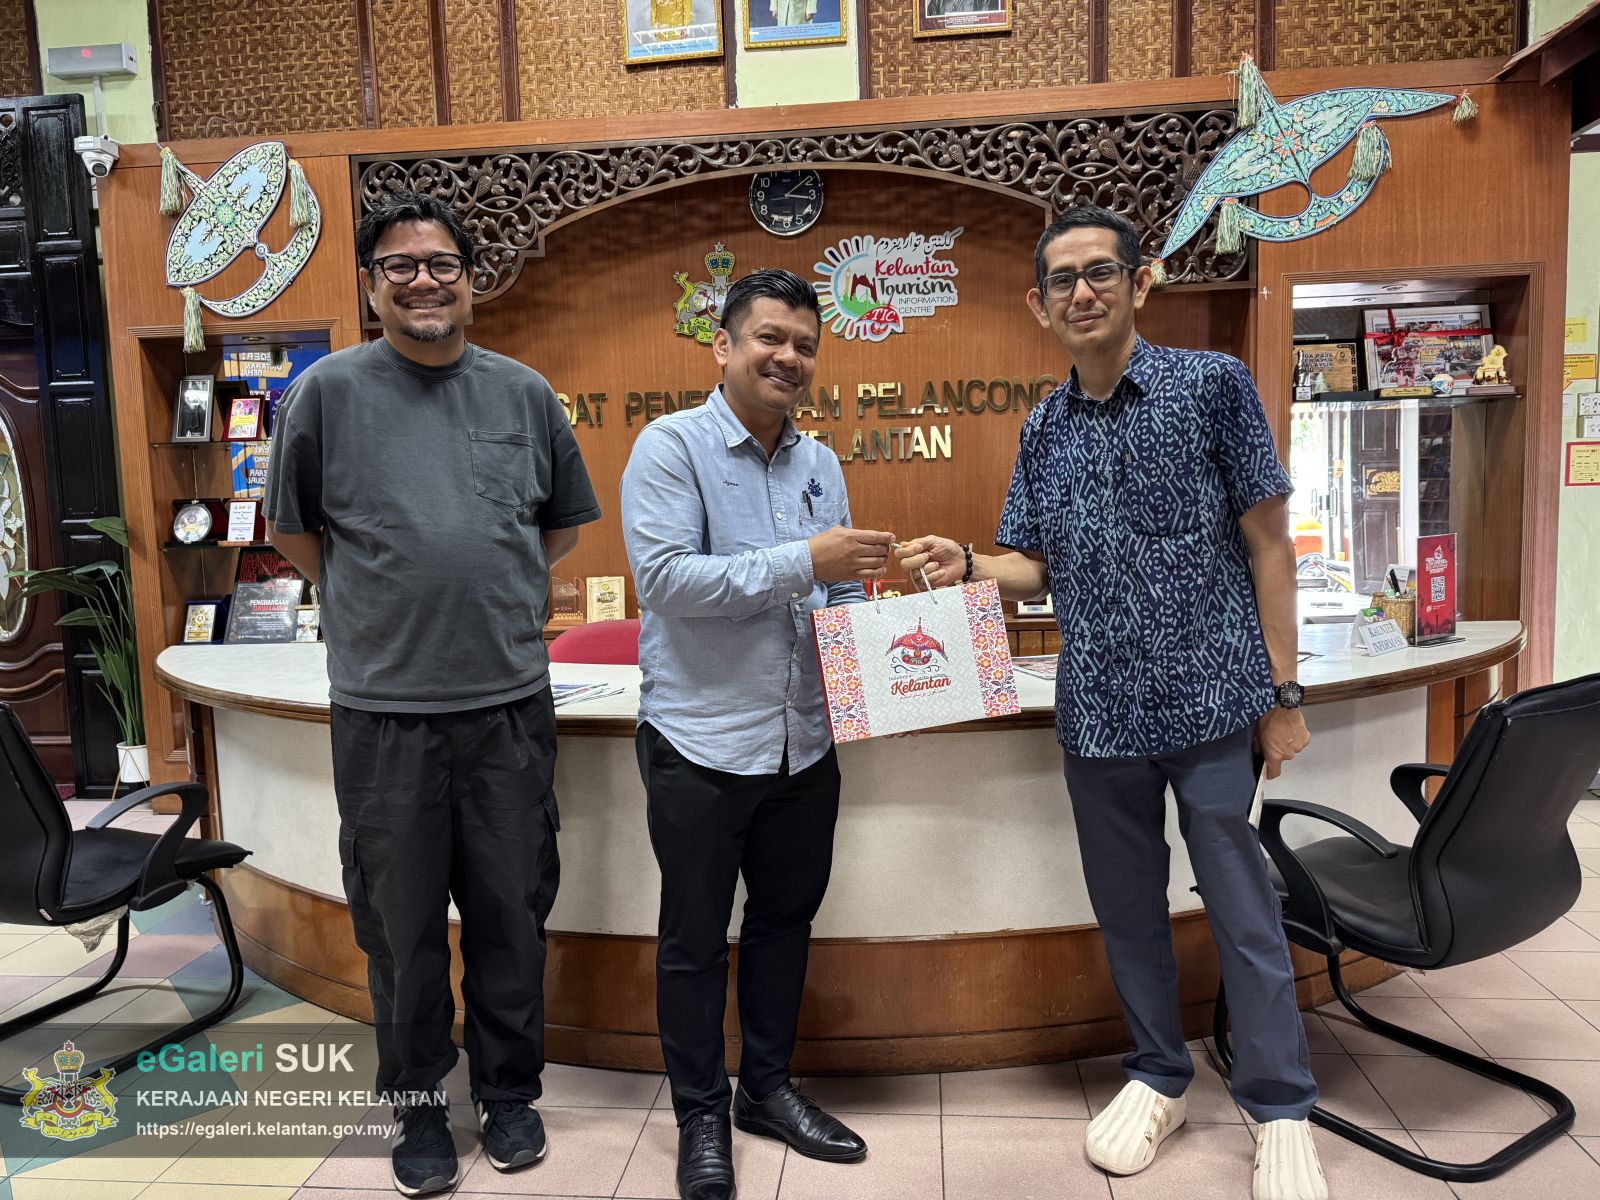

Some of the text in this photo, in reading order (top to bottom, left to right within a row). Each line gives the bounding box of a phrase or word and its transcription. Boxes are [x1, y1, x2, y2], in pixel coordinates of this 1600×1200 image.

[760, 177, 771, 188] 10
[756, 190, 765, 201] 9
[808, 189, 817, 200] 3
[760, 204, 768, 215] 8
[795, 214, 803, 225] 5
[875, 256, 955, 277] Kelantan
[877, 277, 955, 296] Tourism
[898, 296, 956, 305] INFORMATION
[871, 308, 896, 321] TIC
[898, 306, 933, 314] CENTRE
[556, 392, 609, 427] SAT
[857, 374, 1059, 418] PELANCONG
[890, 676, 952, 696] Kelantan
